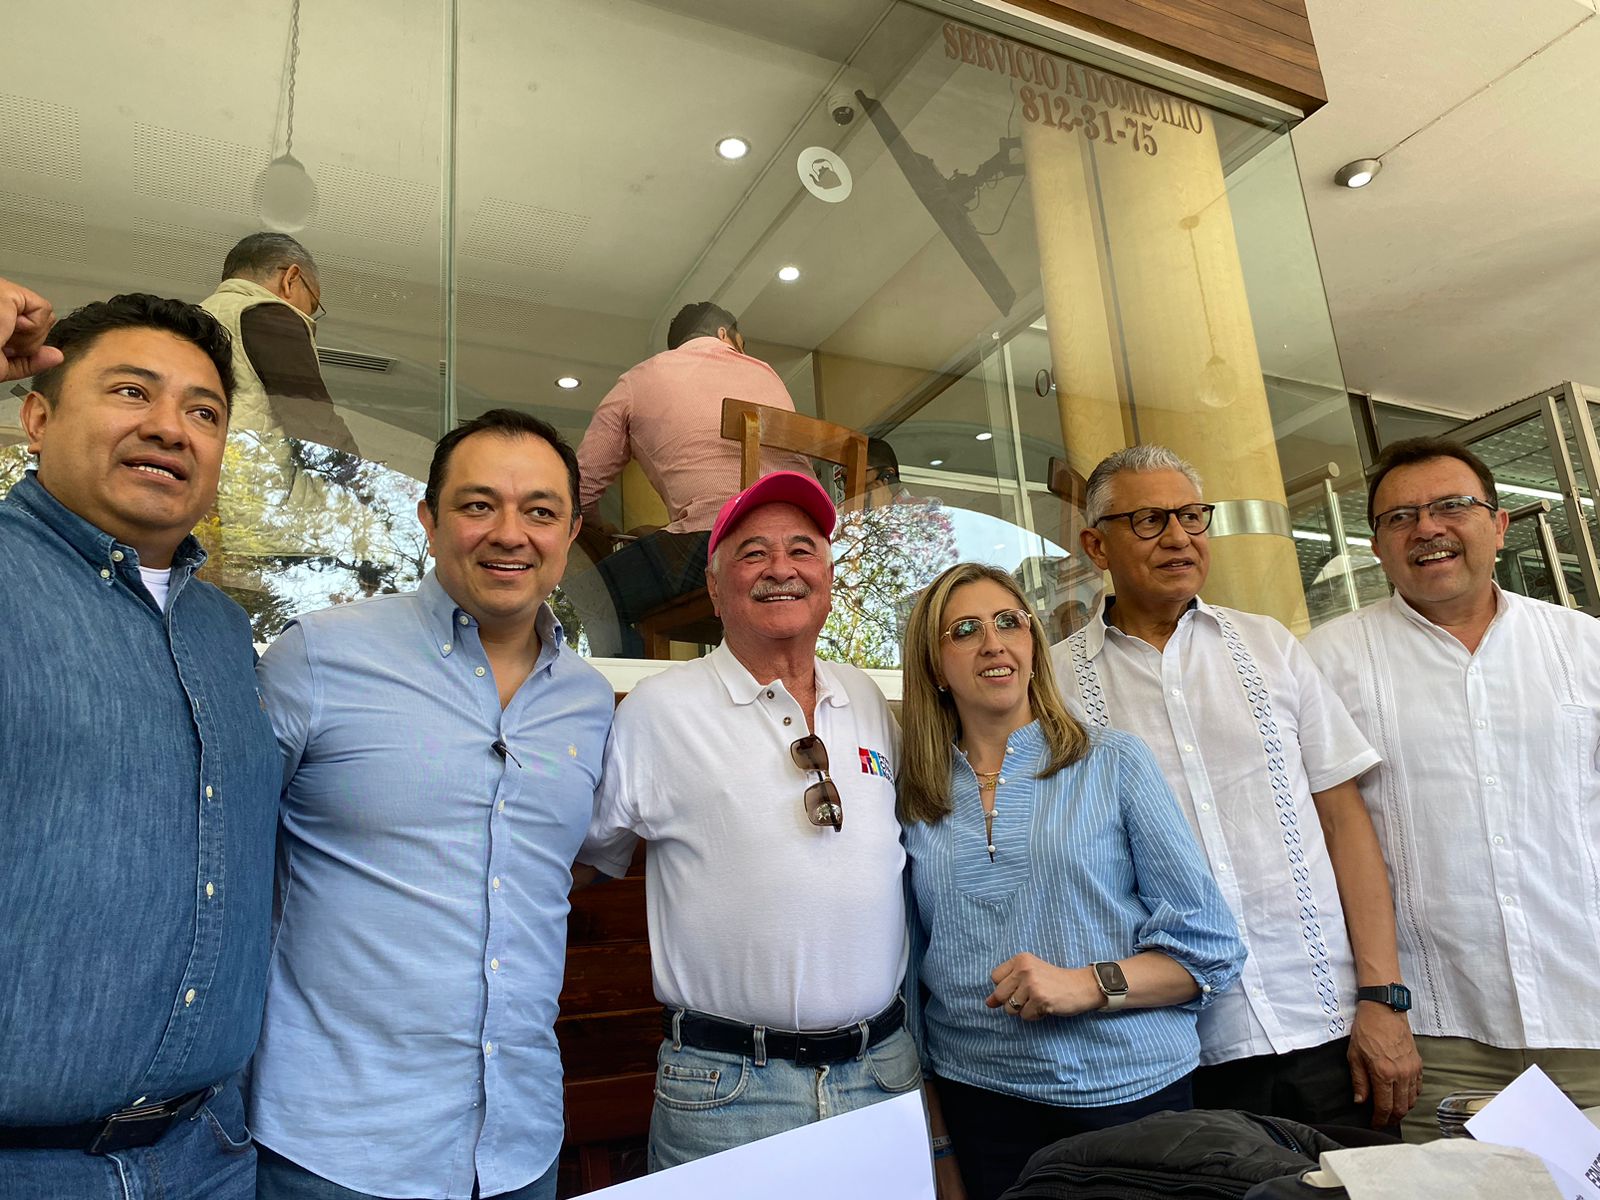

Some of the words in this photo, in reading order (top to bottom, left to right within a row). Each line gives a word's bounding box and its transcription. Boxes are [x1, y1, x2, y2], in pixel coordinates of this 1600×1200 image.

[942, 22, 1060, 90] SERVICIO
[1064, 63, 1082, 98] A
[1082, 67, 1204, 135] DOMICILIO
[1019, 85, 1158, 157] 812-31-75
